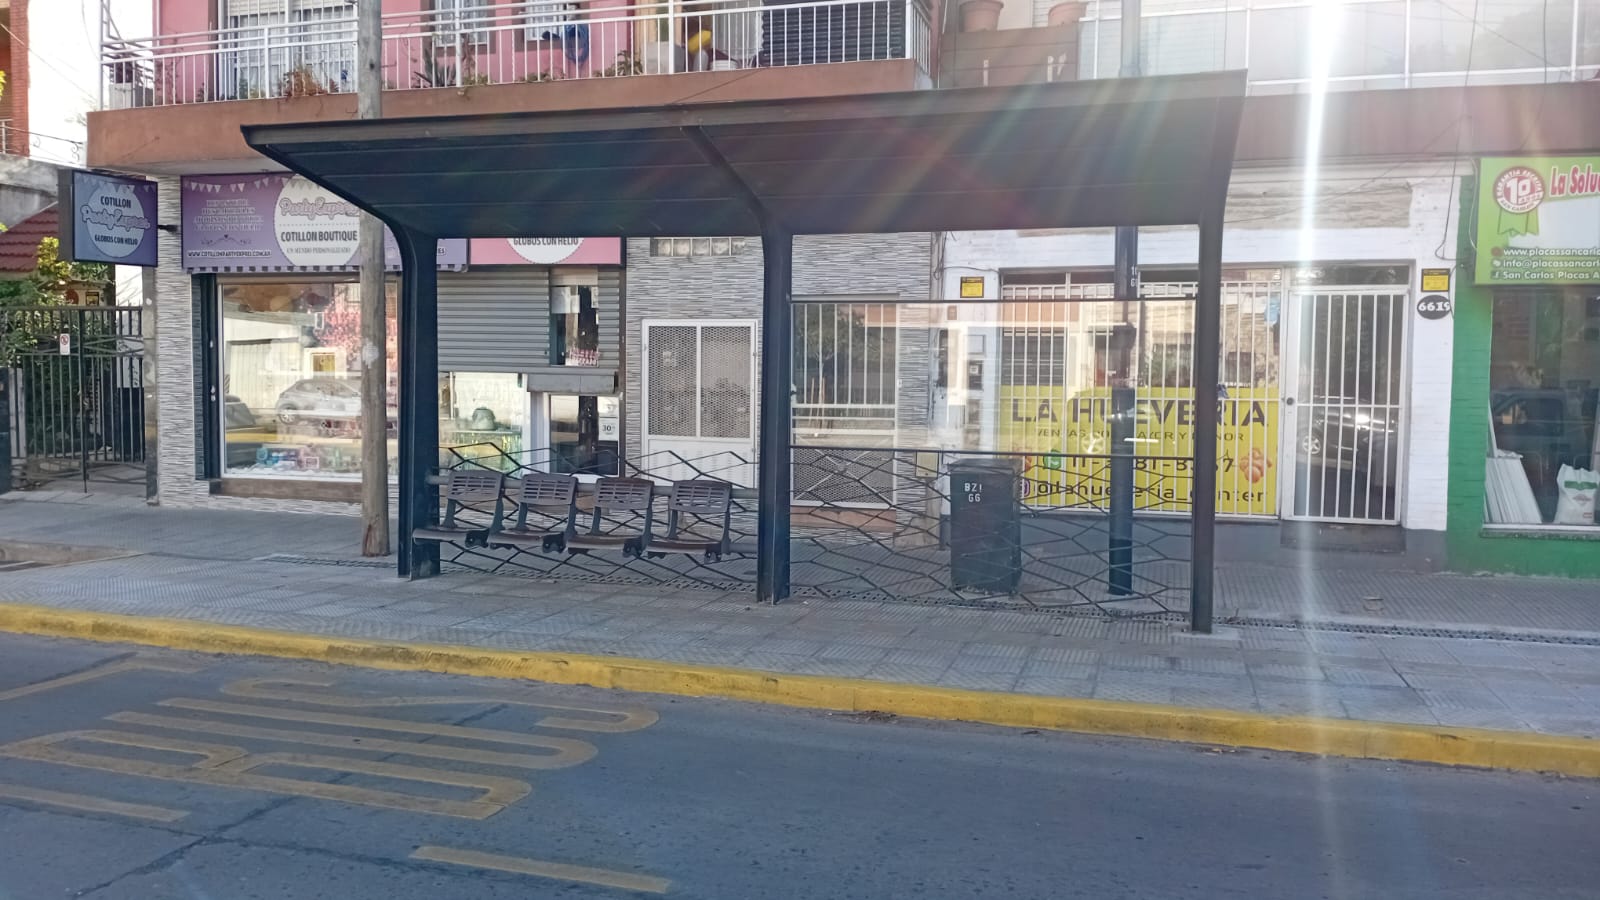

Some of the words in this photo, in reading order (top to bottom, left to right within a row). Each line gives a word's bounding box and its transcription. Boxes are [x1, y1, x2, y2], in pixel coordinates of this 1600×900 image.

[1550, 166, 1567, 196] La
[1569, 163, 1600, 194] Solu
[100, 195, 131, 209] COTILLON
[113, 236, 124, 244] CON
[281, 231, 318, 242] COTILLON
[318, 230, 358, 242] BOUTIQUE
[513, 237, 541, 246] GLOBOS
[542, 237, 557, 246] CON
[557, 237, 579, 246] HELIO
[1503, 271, 1521, 279] San
[1524, 271, 1554, 279] Carlos
[1558, 271, 1590, 279] Placas
[1011, 398, 1058, 422] LA
